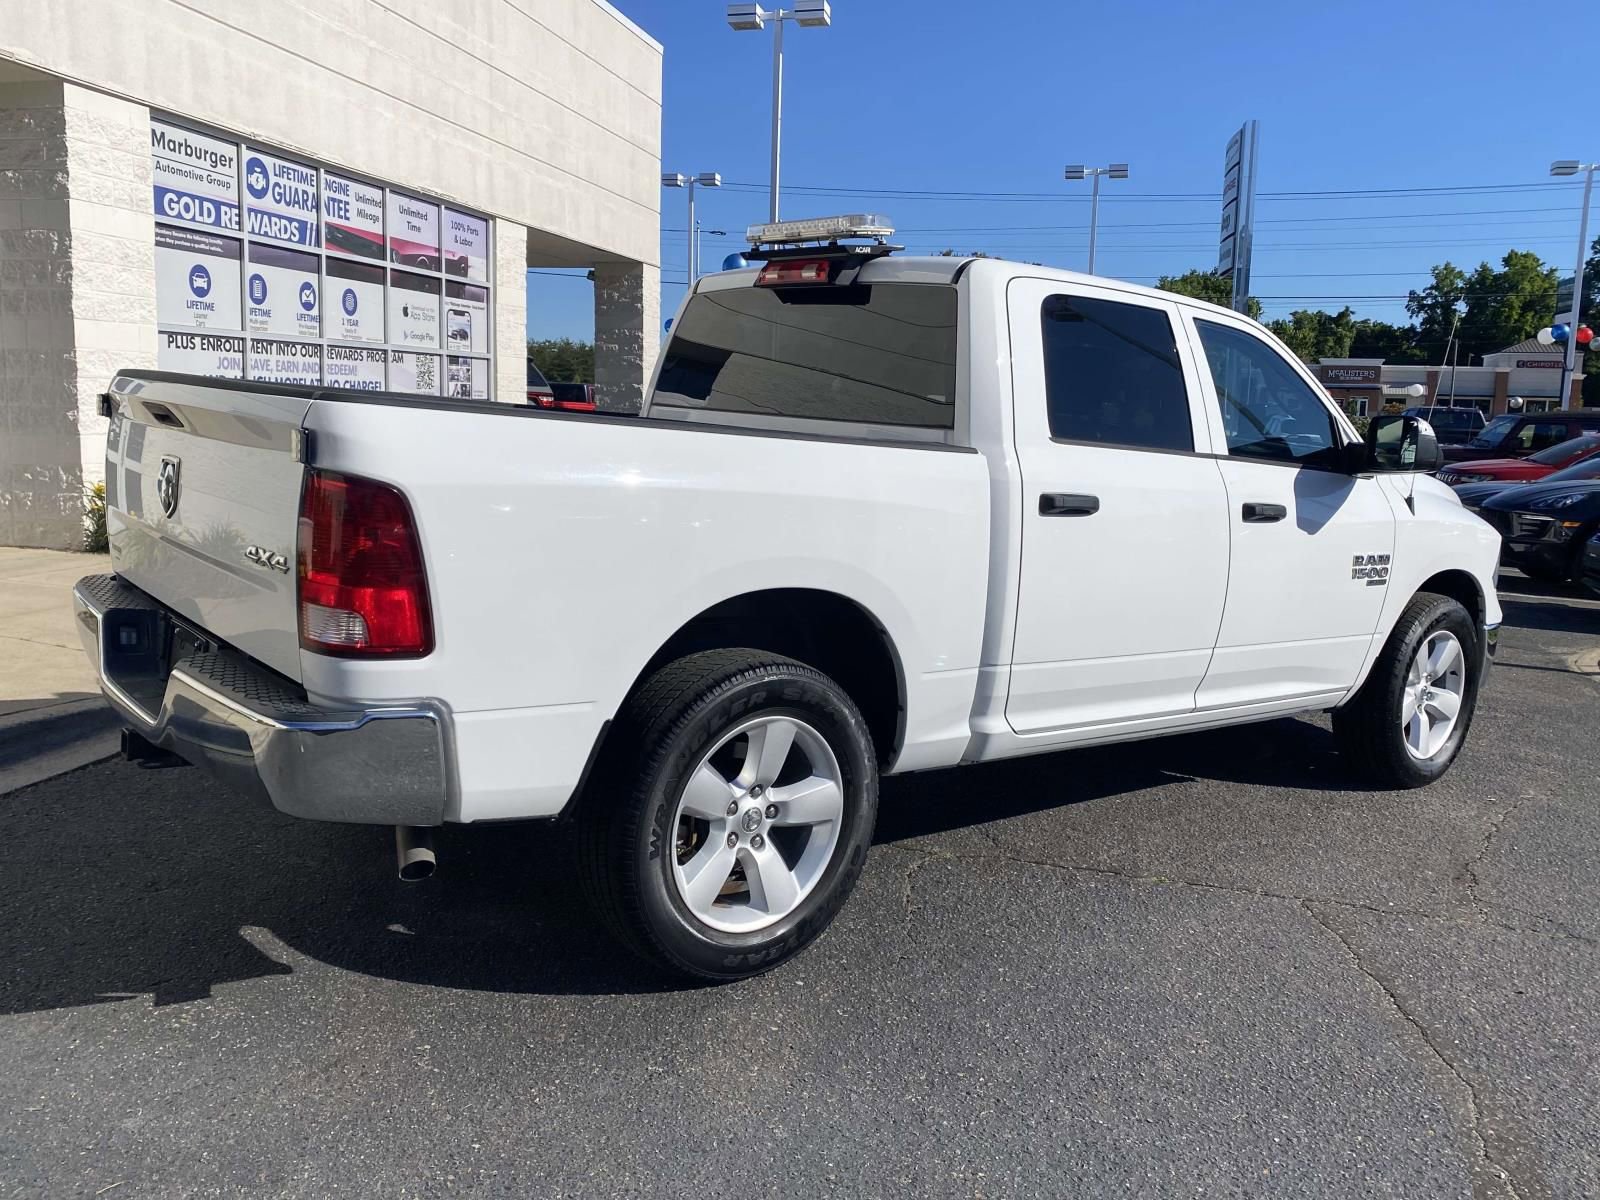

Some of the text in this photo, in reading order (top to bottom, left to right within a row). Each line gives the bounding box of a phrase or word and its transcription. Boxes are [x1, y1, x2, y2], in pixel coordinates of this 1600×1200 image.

[151, 128, 234, 169] Marburger
[155, 160, 231, 191] Automotive Group
[273, 163, 315, 187] LIFETIME
[163, 192, 216, 224] GOLD
[354, 191, 382, 209] Unlimited
[356, 207, 380, 224] Mileage
[398, 205, 428, 222] Unlimited
[406, 221, 422, 233] Time
[450, 220, 479, 236] 100% Parts
[459, 235, 474, 248] Labor
[186, 299, 215, 312] LIFETIME
[296, 312, 320, 323] LIFETIME
[346, 318, 359, 327] YEAR
[167, 334, 196, 350] PLUS
[275, 343, 298, 356] INTO
[300, 345, 319, 358] OUR
[276, 360, 299, 373] EARN
[301, 361, 320, 374] AND
[1352, 554, 1391, 567] RAM
[1351, 566, 1389, 580] 1500
